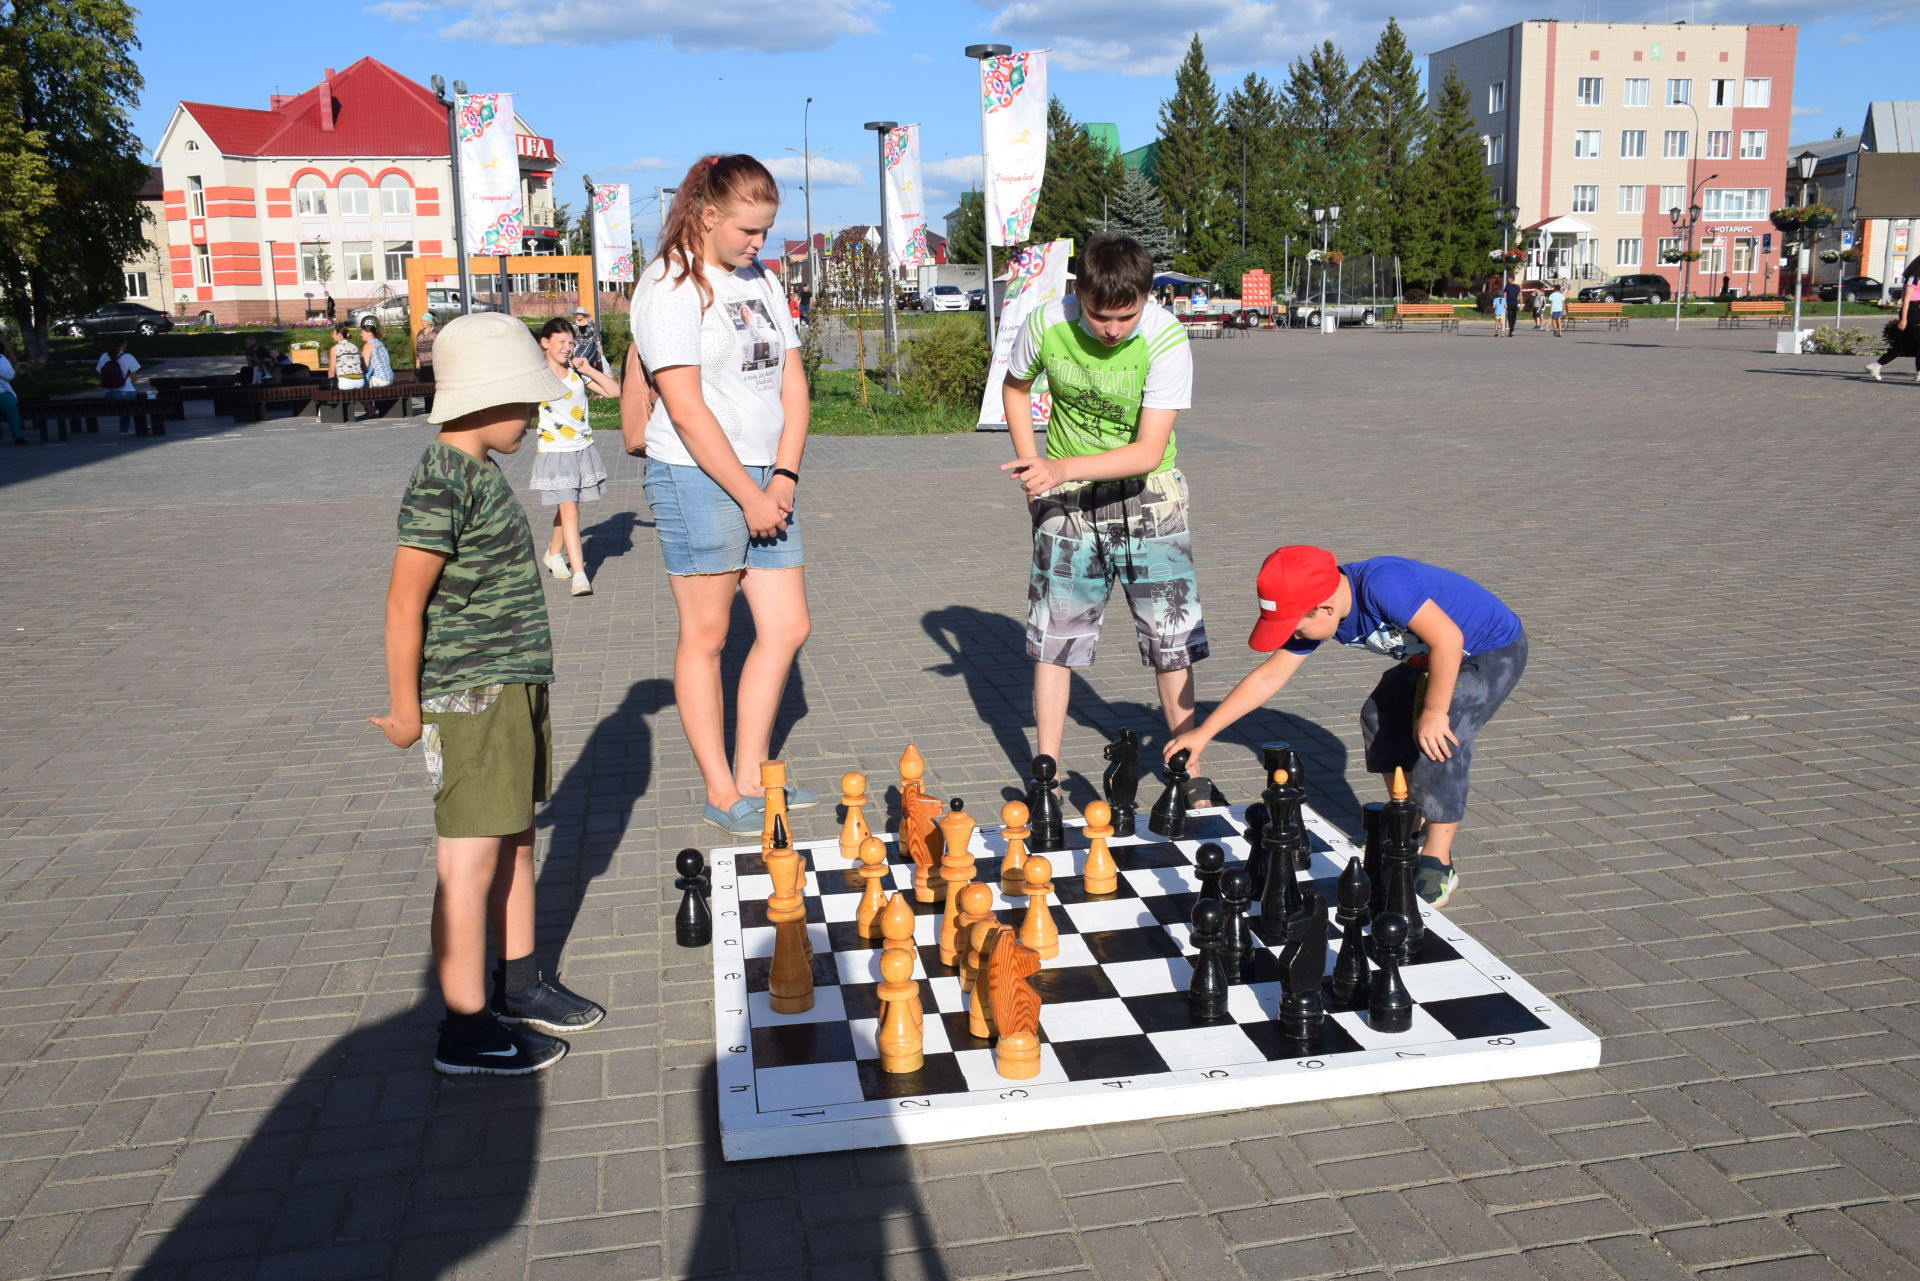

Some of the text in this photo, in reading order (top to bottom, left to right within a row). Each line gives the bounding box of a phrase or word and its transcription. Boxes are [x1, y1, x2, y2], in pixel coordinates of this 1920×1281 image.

[1714, 225, 1753, 233] НОТАРИУС
[1050, 353, 1138, 371] AMRICAN
[1047, 357, 1141, 398] FOOTBALL
[899, 1099, 932, 1108] 2
[1000, 1089, 1029, 1100] 3
[1101, 1079, 1132, 1089] 4
[1200, 1069, 1230, 1079] 5
[1296, 1059, 1325, 1069] 6
[1395, 1051, 1426, 1059] 7
[1487, 1036, 1516, 1046] 8
